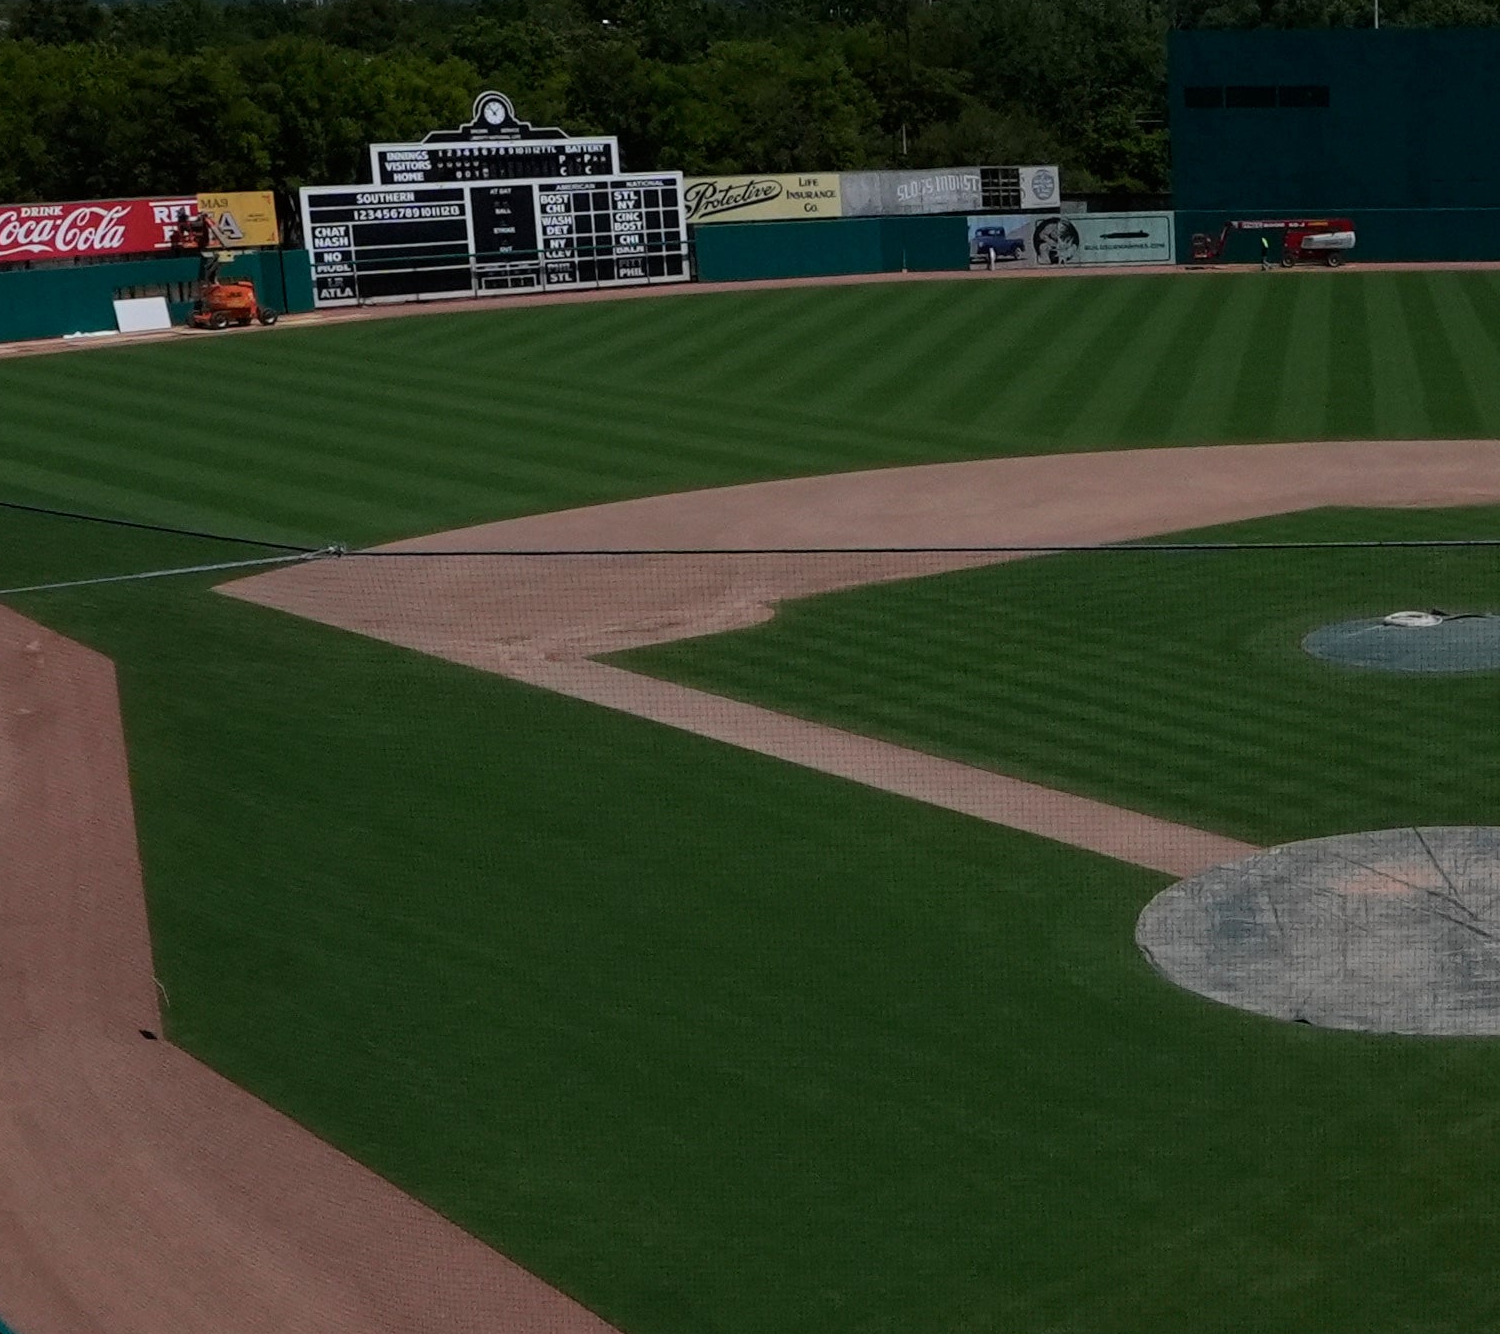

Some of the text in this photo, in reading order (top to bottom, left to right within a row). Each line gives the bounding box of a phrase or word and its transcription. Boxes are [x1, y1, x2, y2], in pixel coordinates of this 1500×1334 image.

[387, 151, 429, 162] INNINGS
[385, 160, 432, 172] VISITORS
[393, 171, 425, 183] HOME
[356, 192, 415, 204] SOUTHERN
[540, 194, 569, 204] BOST
[613, 190, 638, 201] STL
[683, 180, 782, 219] Protective
[786, 189, 837, 200] INSURANCE
[546, 204, 566, 213] CHI
[617, 200, 635, 210] NY
[20, 205, 63, 218] DRINK
[615, 212, 640, 222] CINC
[541, 216, 572, 226] WASH
[614, 221, 642, 232] BOST
[314, 226, 346, 237] CHAT
[546, 225, 569, 236] DET
[314, 237, 349, 248] NASH
[550, 239, 566, 249] NY
[619, 234, 640, 244] CHI
[323, 252, 342, 263] NO
[550, 272, 573, 283] STL
[619, 267, 646, 278] PHIL
[320, 287, 354, 299] ATLA
